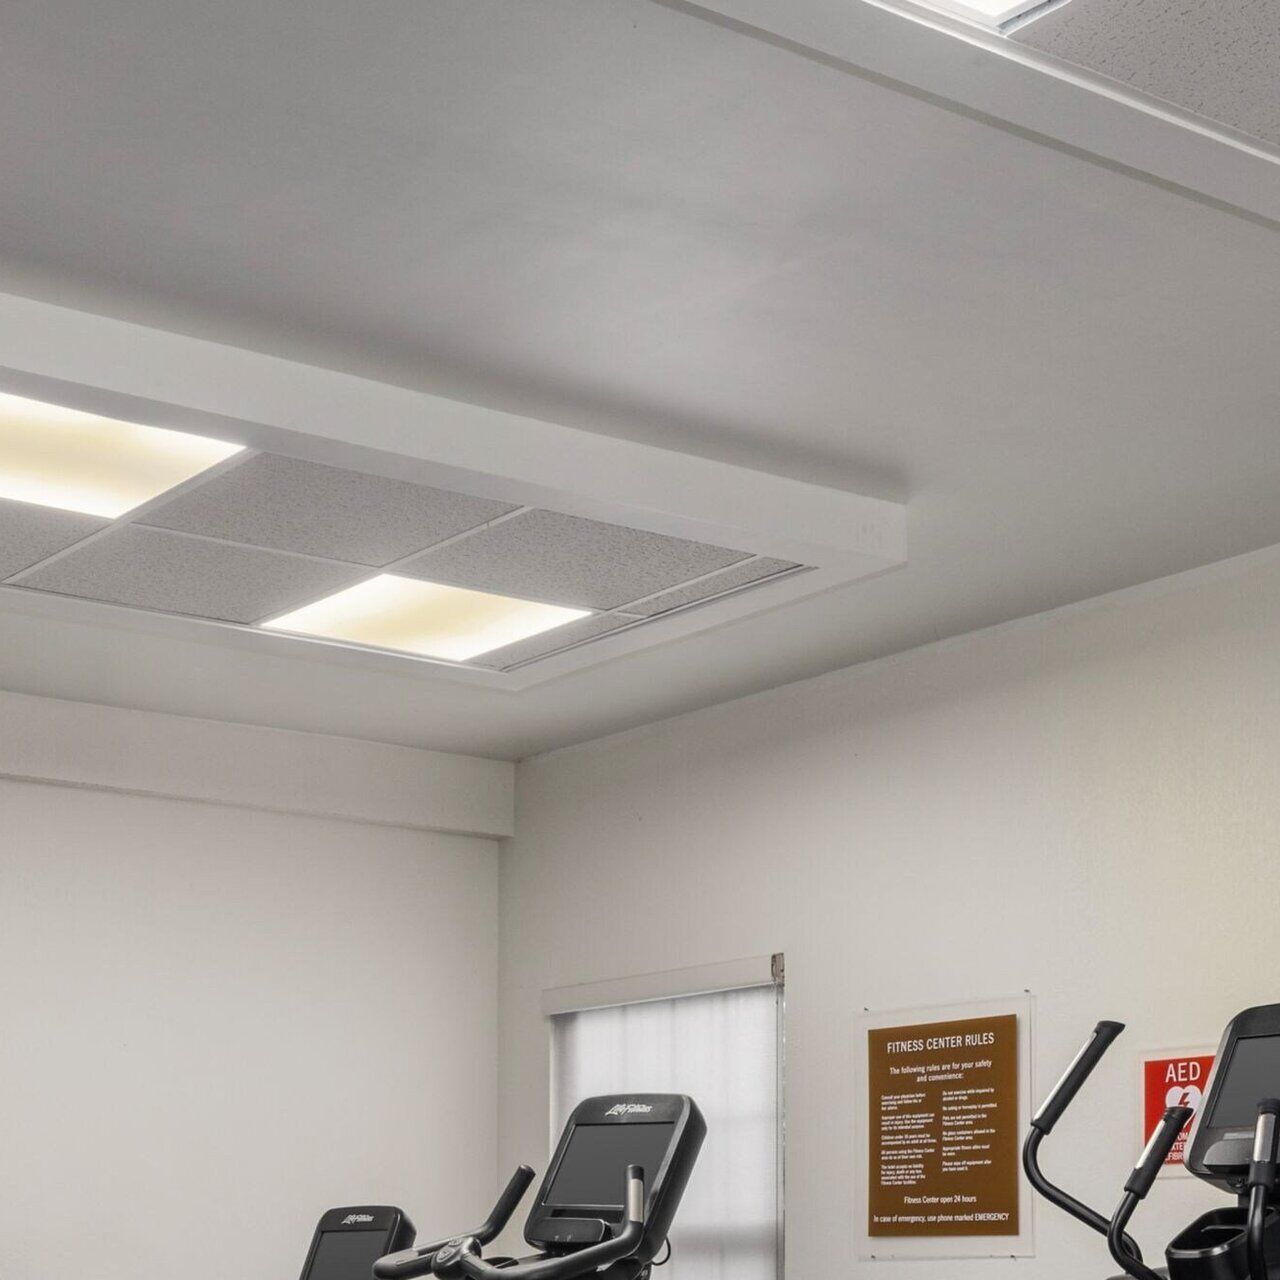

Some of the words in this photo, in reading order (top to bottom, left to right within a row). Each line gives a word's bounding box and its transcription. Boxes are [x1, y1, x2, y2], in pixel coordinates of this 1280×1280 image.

[887, 1039, 924, 1055] FITNESS
[926, 1035, 963, 1050] CENTER
[965, 1032, 995, 1047] RULES
[889, 1066, 900, 1075] The
[901, 1064, 926, 1074] following
[926, 1063, 940, 1072] rules
[941, 1063, 951, 1071] are
[951, 1061, 960, 1070] for
[961, 1061, 974, 1071] your
[975, 1059, 993, 1069] safety
[1165, 1061, 1201, 1083] AED
[916, 1074, 927, 1083] and
[904, 1196, 922, 1204] Fitness
[922, 1195, 939, 1204] Center
[940, 1196, 953, 1204] open
[953, 1195, 961, 1203] 24
[961, 1195, 977, 1203] hours
[974, 1212, 1010, 1221] EMERGENCY
